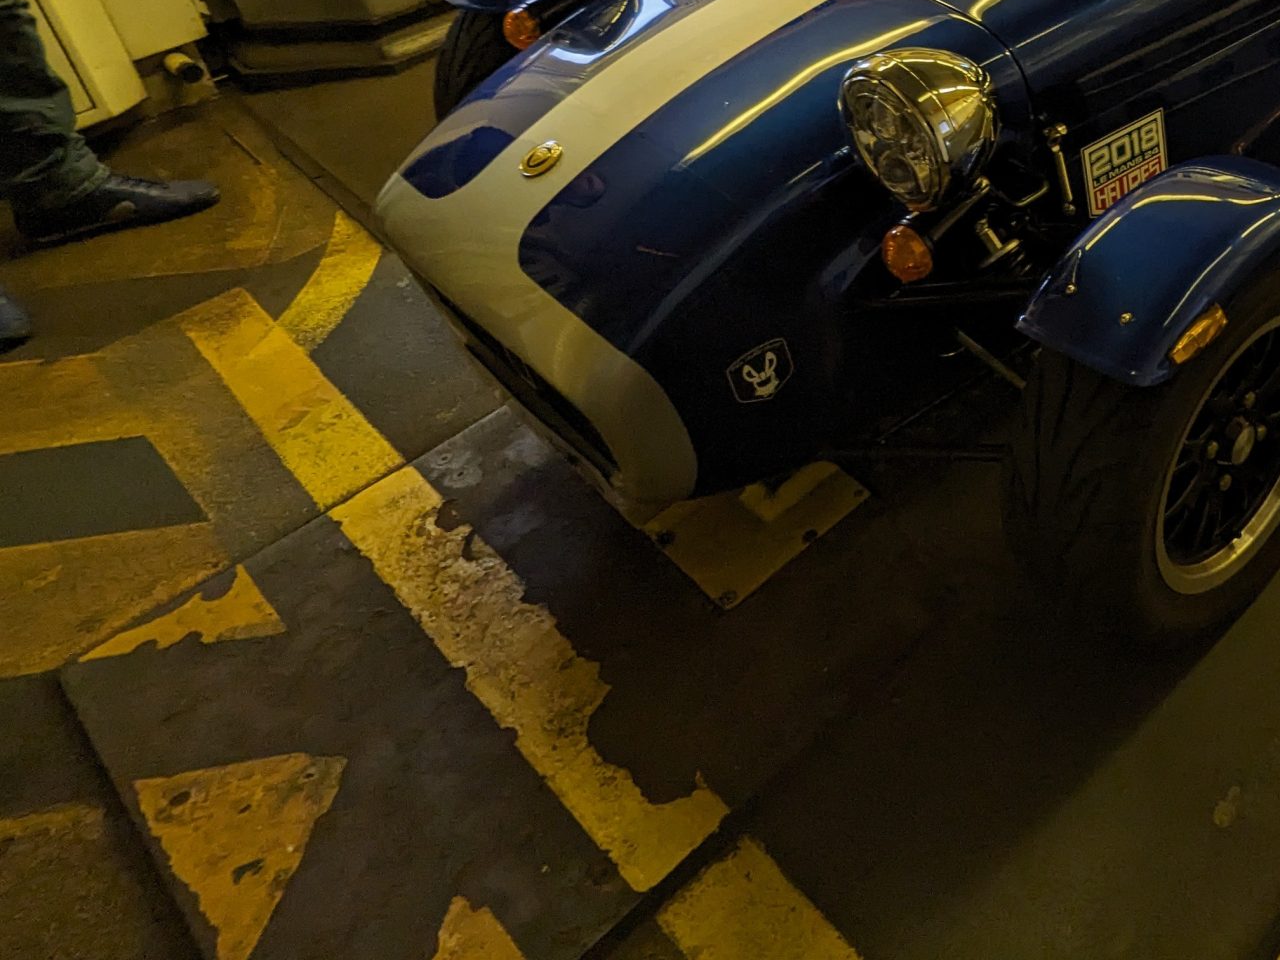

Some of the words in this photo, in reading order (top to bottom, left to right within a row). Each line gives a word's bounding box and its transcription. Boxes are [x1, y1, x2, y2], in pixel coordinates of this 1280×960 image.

[1090, 120, 1160, 178] 2018
[1094, 174, 1108, 188] LE
[1109, 155, 1143, 179] MANS
[1143, 146, 1159, 160] 24
